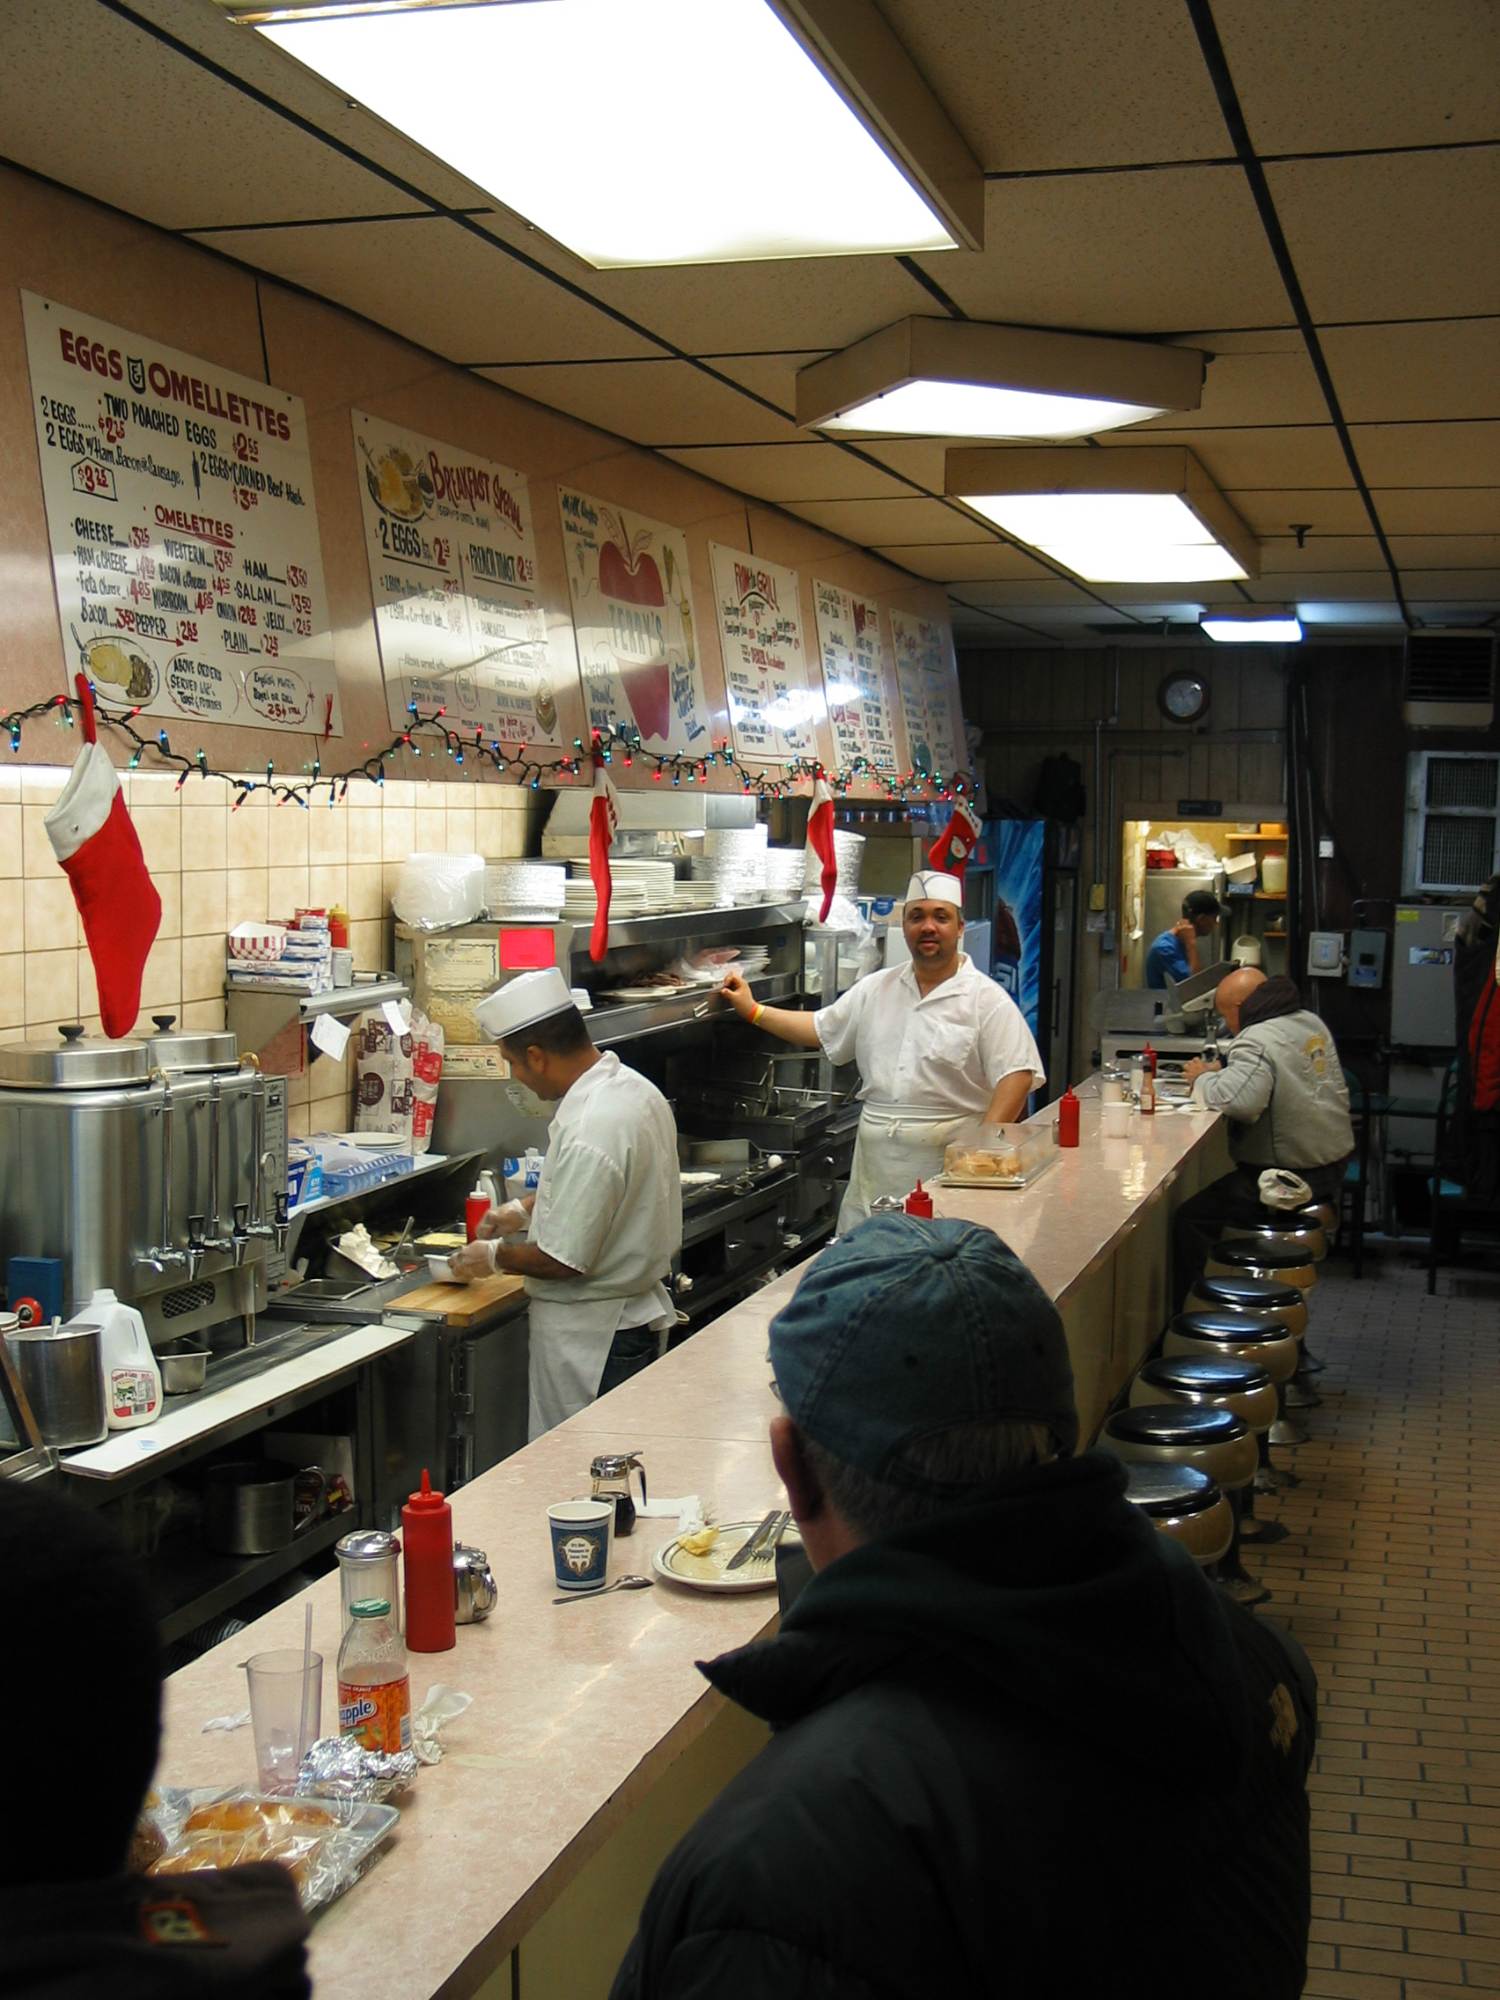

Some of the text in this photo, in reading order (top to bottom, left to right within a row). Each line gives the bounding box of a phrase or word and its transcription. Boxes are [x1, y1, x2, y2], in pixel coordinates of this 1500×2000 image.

[59, 328, 123, 381] EGGS
[149, 362, 291, 441] OMELLETTES
[104, 392, 217, 449] TWO POACHED EGGS
[58, 427, 85, 455] EGGS
[428, 450, 490, 512] BREAKFAST
[75, 517, 114, 546] CHEESE
[154, 504, 234, 540] OMELETTES
[391, 522, 421, 559] EGGS
[244, 558, 268, 580] HAM
[236, 581, 277, 606] SALAMI
[81, 596, 108, 627] Bacon
[135, 612, 169, 638] PEPPER
[223, 629, 249, 650] PLAIN
